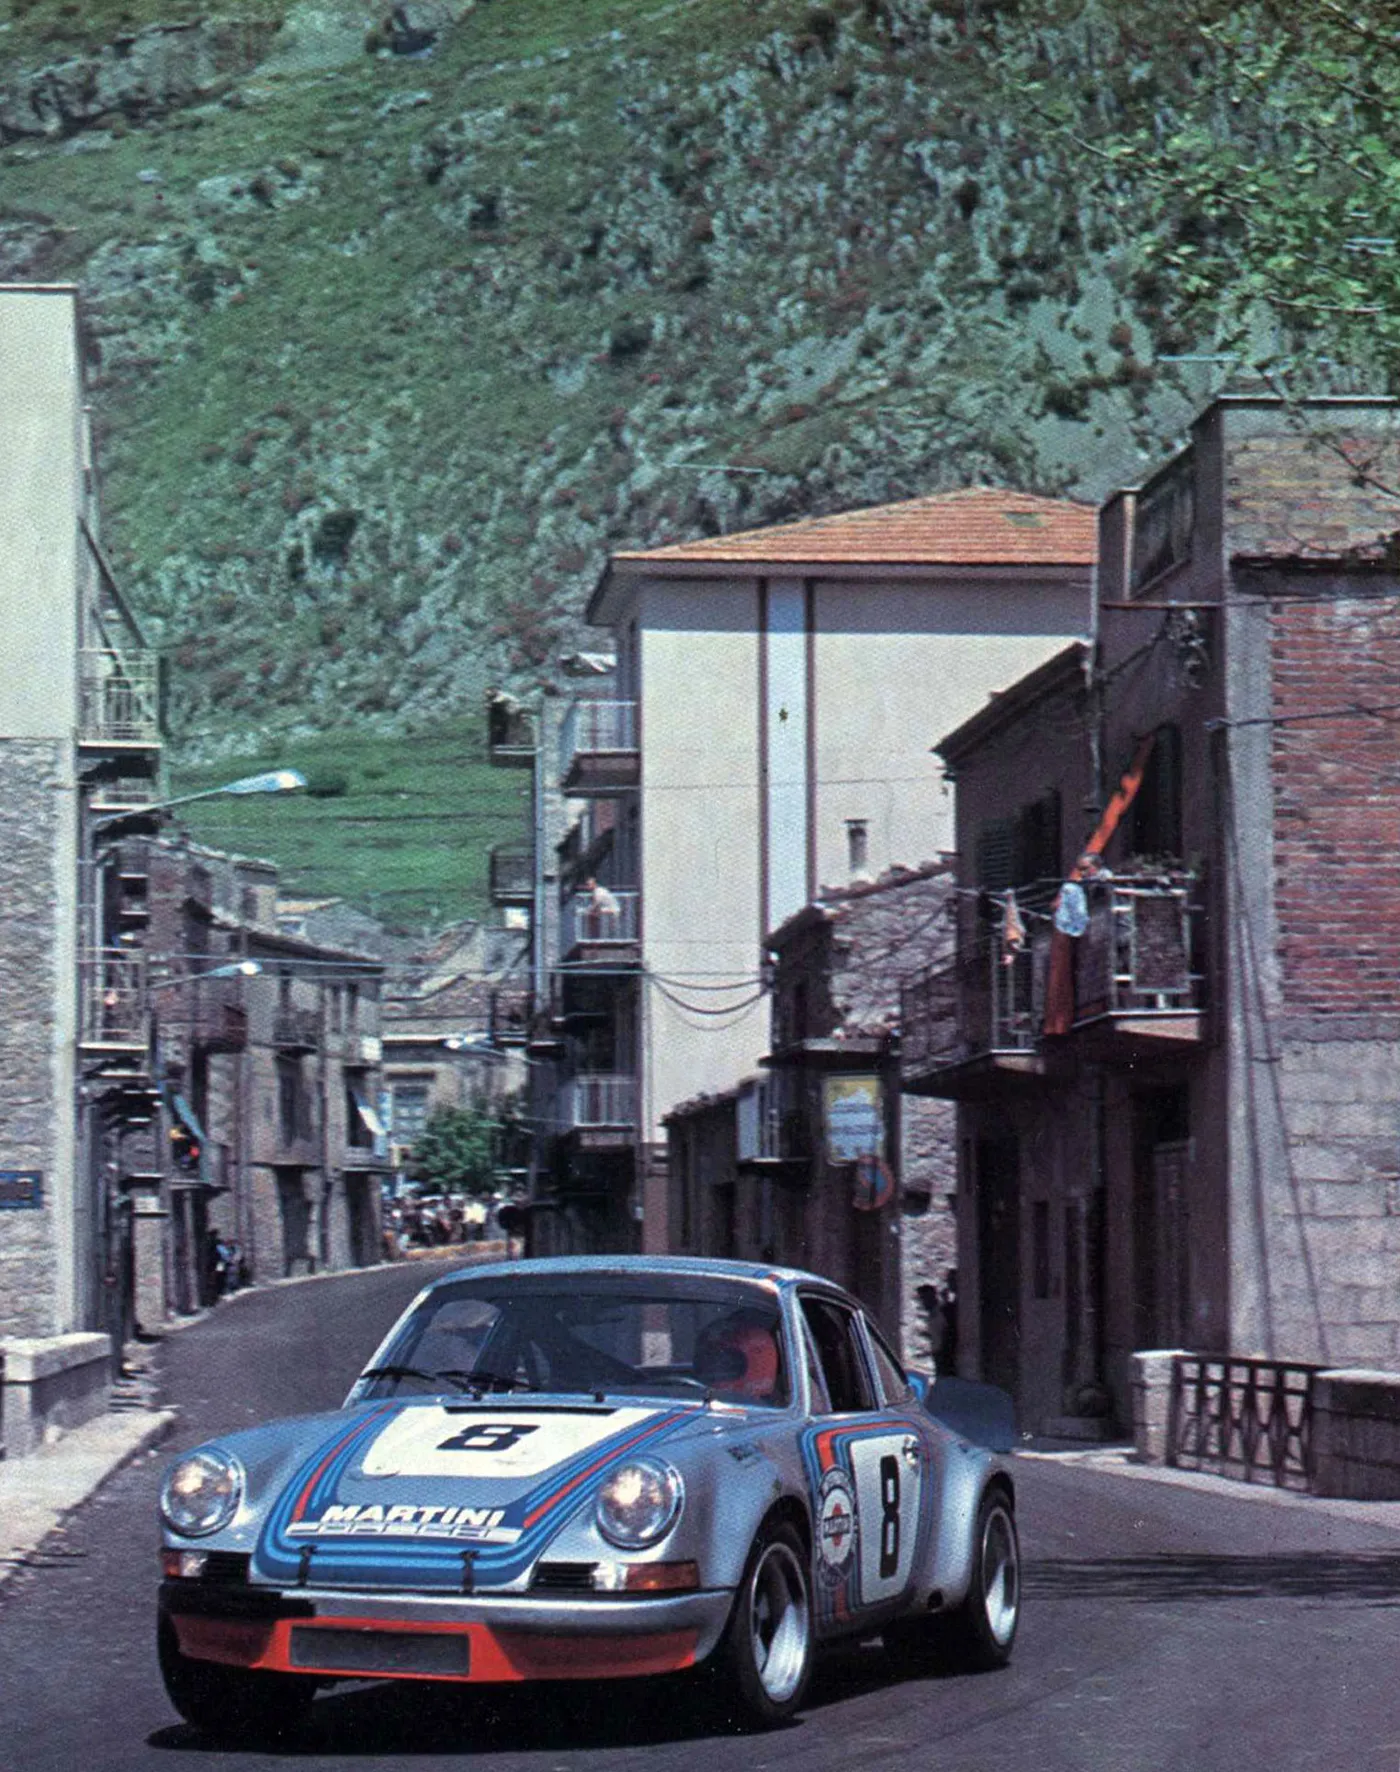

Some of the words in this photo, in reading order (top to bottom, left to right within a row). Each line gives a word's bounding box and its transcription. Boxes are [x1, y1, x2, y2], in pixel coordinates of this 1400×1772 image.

[436, 1424, 541, 1452] 8
[320, 1505, 506, 1527] MARTINI
[879, 1454, 900, 1580] 8
